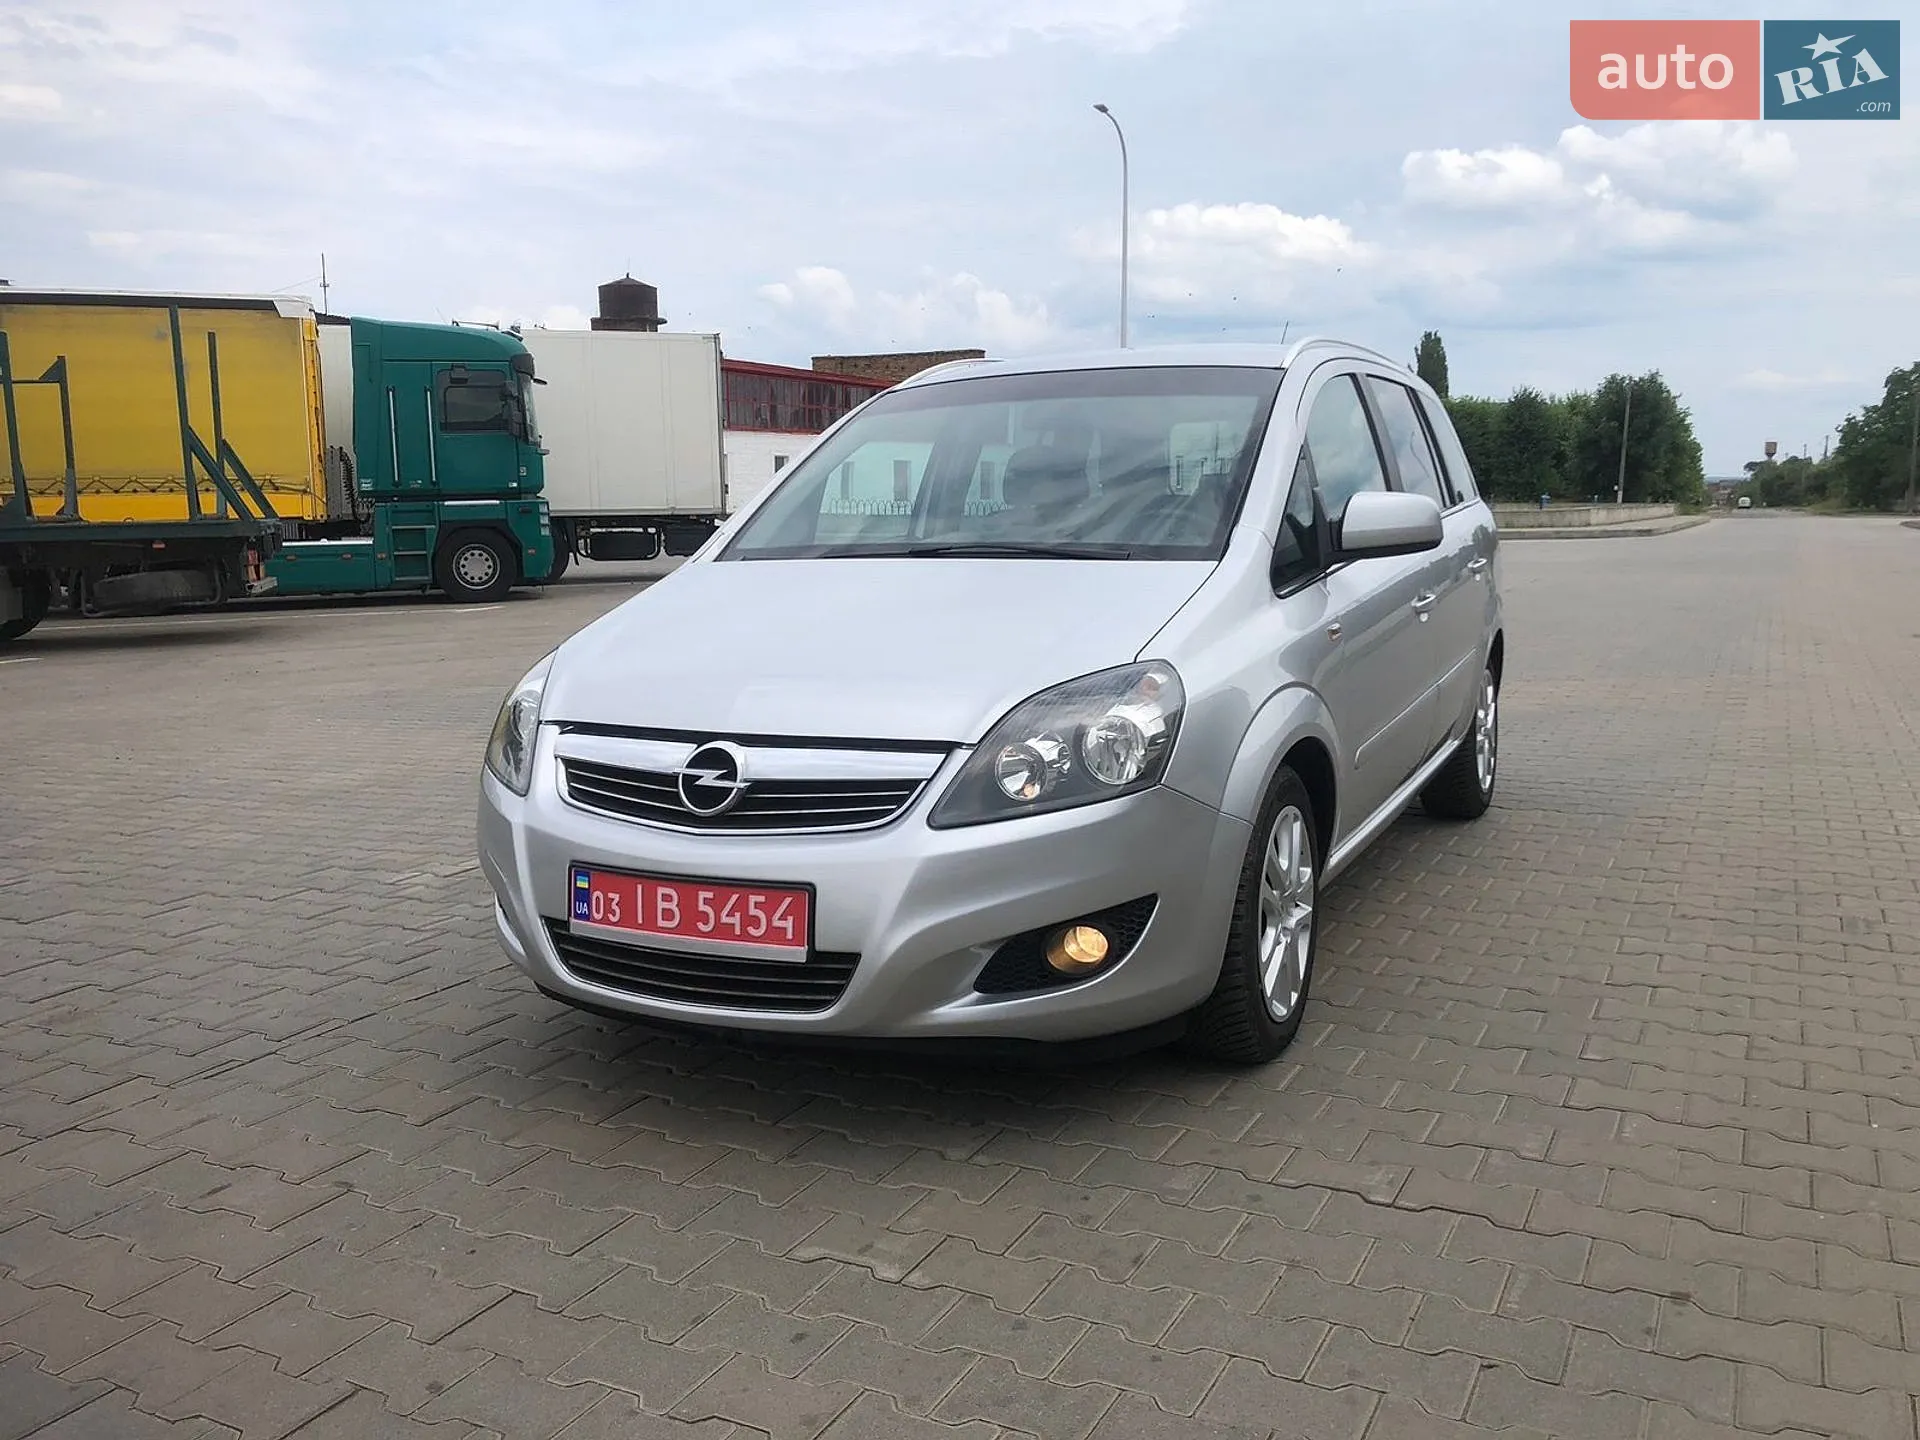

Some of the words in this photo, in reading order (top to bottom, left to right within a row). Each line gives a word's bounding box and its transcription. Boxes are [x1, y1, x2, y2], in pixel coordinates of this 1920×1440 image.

[576, 902, 589, 915] UA
[592, 890, 620, 923] 03
[696, 891, 795, 940] 5454
